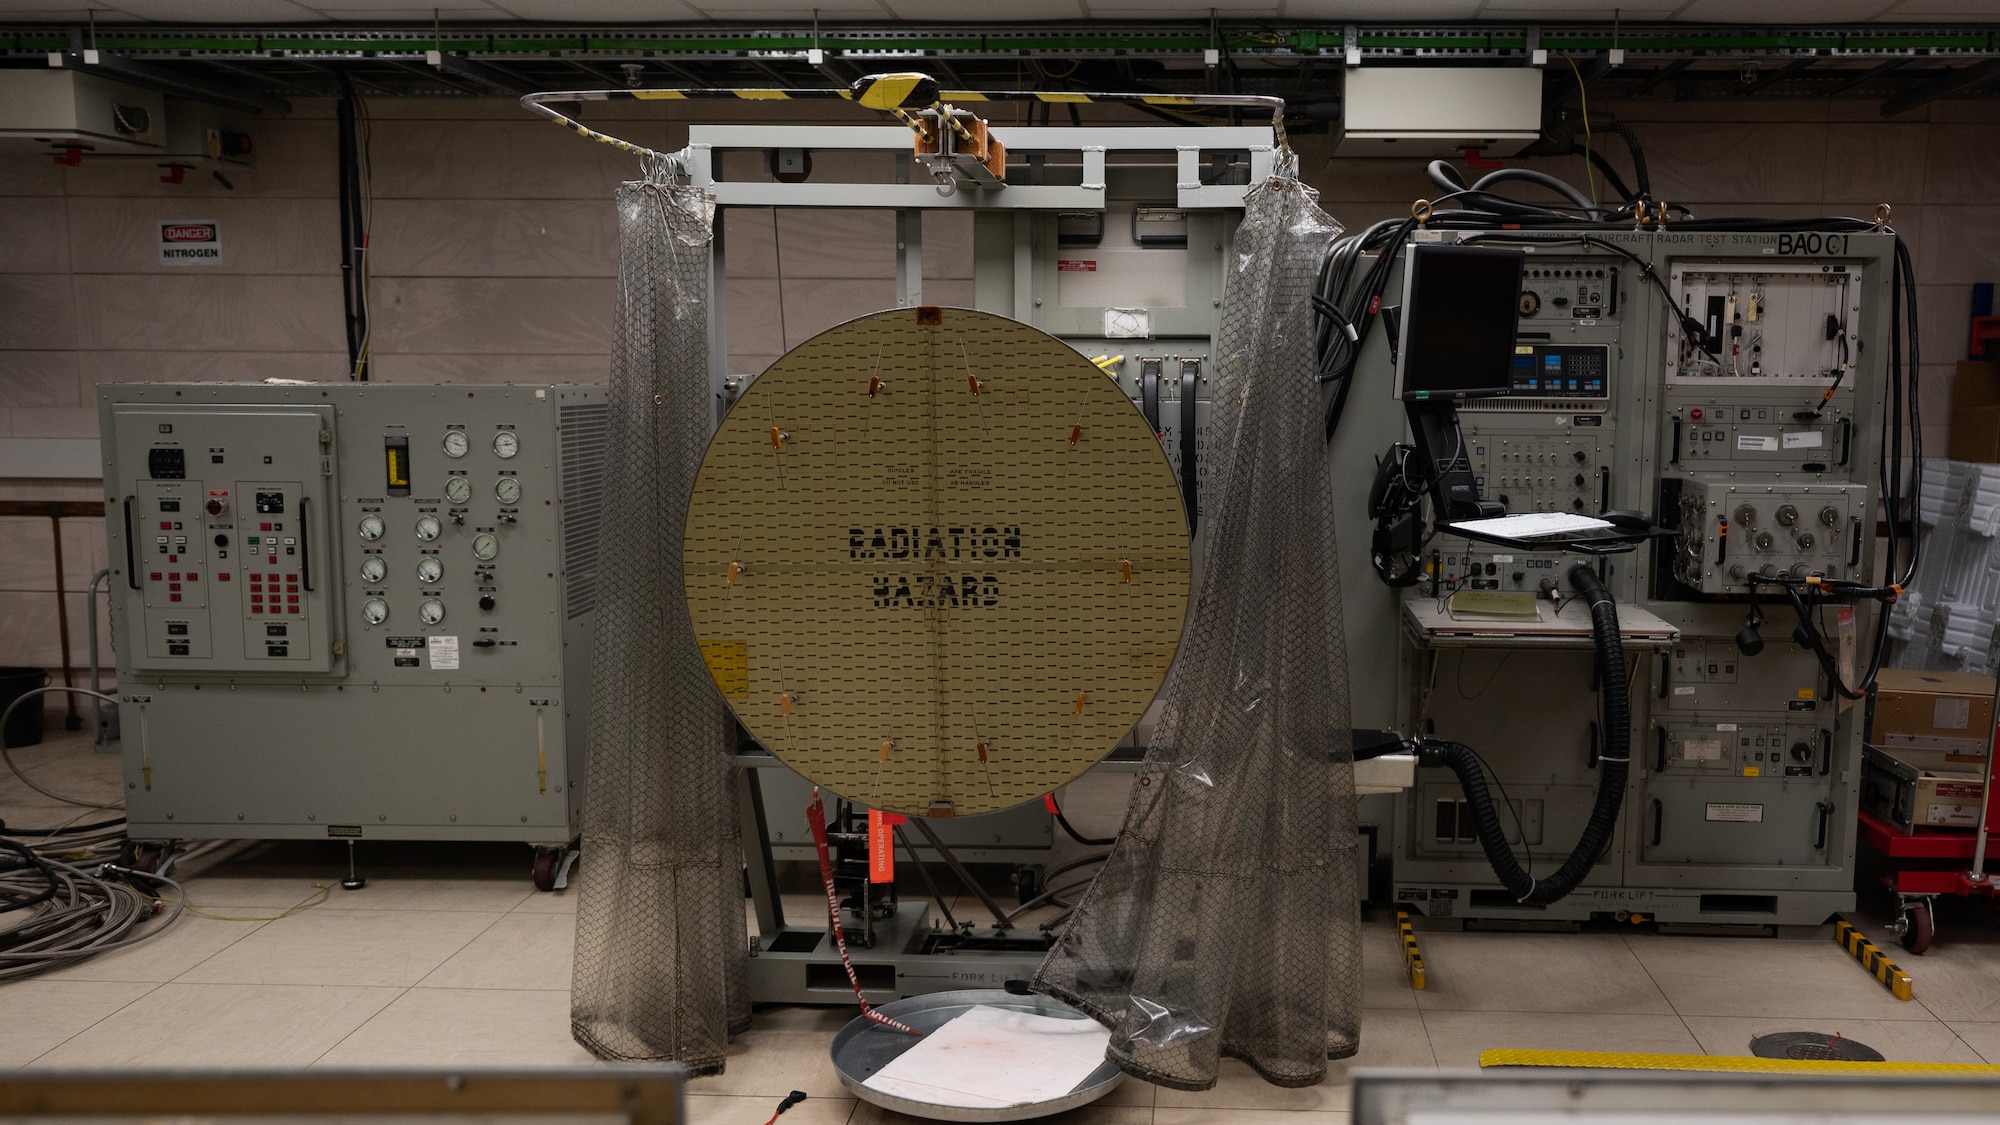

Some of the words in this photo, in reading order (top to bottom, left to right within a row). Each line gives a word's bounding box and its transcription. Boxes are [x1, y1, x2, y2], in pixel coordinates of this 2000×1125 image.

[167, 227, 210, 239] DANGER
[1598, 233, 1652, 243] AIRCRAFT
[1656, 234, 1696, 243] RADAR
[1699, 235, 1727, 244] TEST
[1732, 235, 1778, 244] STATION
[163, 248, 218, 258] NITROGEN
[849, 527, 1021, 559] RADIATION
[873, 575, 999, 607] HAZARD
[877, 827, 885, 873] OPERATING
[1593, 889, 1626, 901] FORK
[1627, 889, 1655, 901] LIFT
[952, 971, 985, 983] FORK
